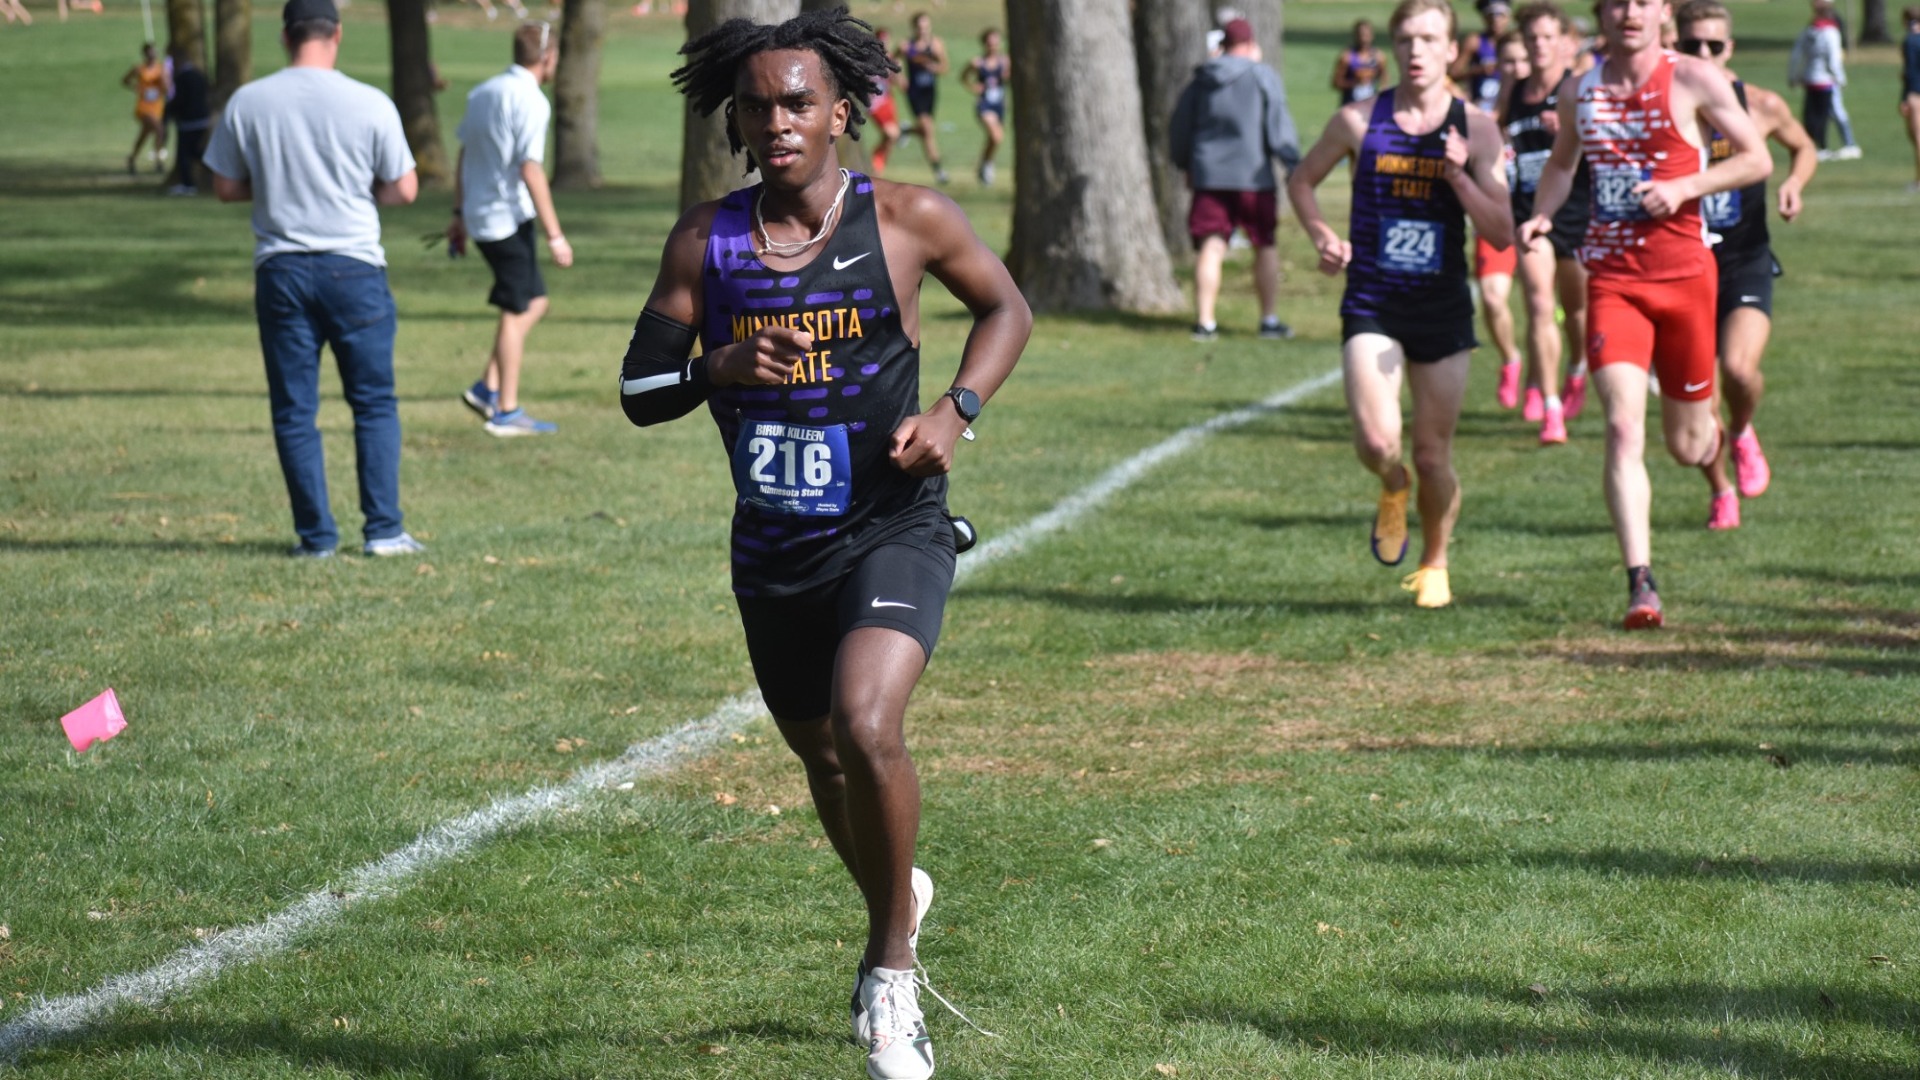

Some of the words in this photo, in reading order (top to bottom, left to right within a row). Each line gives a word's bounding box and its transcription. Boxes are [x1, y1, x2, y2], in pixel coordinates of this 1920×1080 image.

[1375, 154, 1446, 178] MINNESOT
[1392, 179, 1431, 199] STATE
[1384, 227, 1436, 258] 224
[783, 350, 833, 384] ATE
[755, 424, 786, 437] BIRUK
[786, 427, 825, 442] KILLEEN
[748, 437, 832, 486] 216
[759, 485, 799, 497] Minnesota
[801, 489, 824, 497] State
